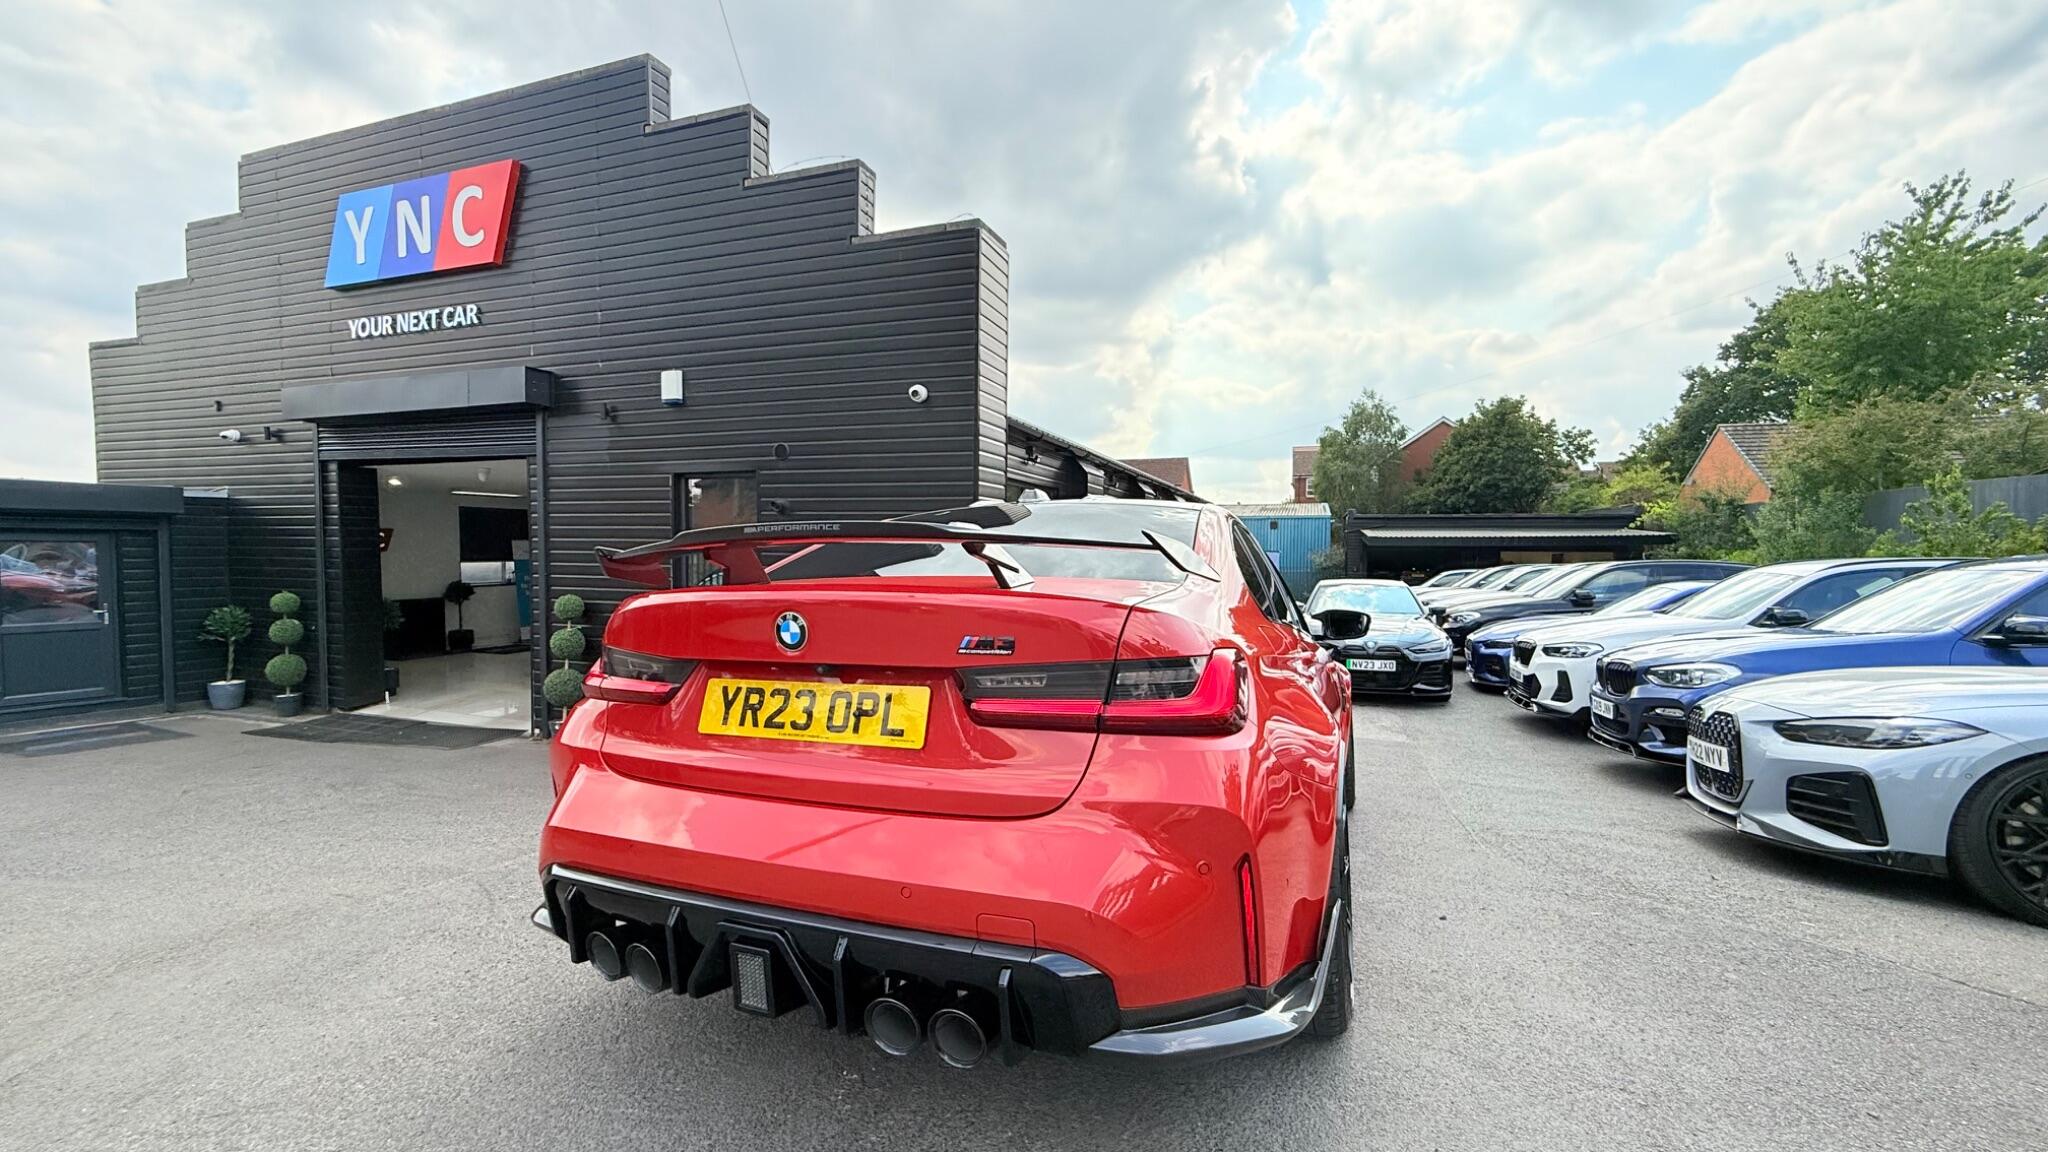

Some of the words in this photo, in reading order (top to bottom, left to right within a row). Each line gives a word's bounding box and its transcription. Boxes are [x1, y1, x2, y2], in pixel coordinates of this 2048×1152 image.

[345, 185, 485, 265] YNC
[348, 315, 393, 340] YOUR
[396, 309, 440, 334] NEXT
[442, 304, 480, 328] CAR
[1352, 660, 1375, 669] NV23
[721, 685, 817, 731] YR23
[826, 690, 905, 738] OPL
